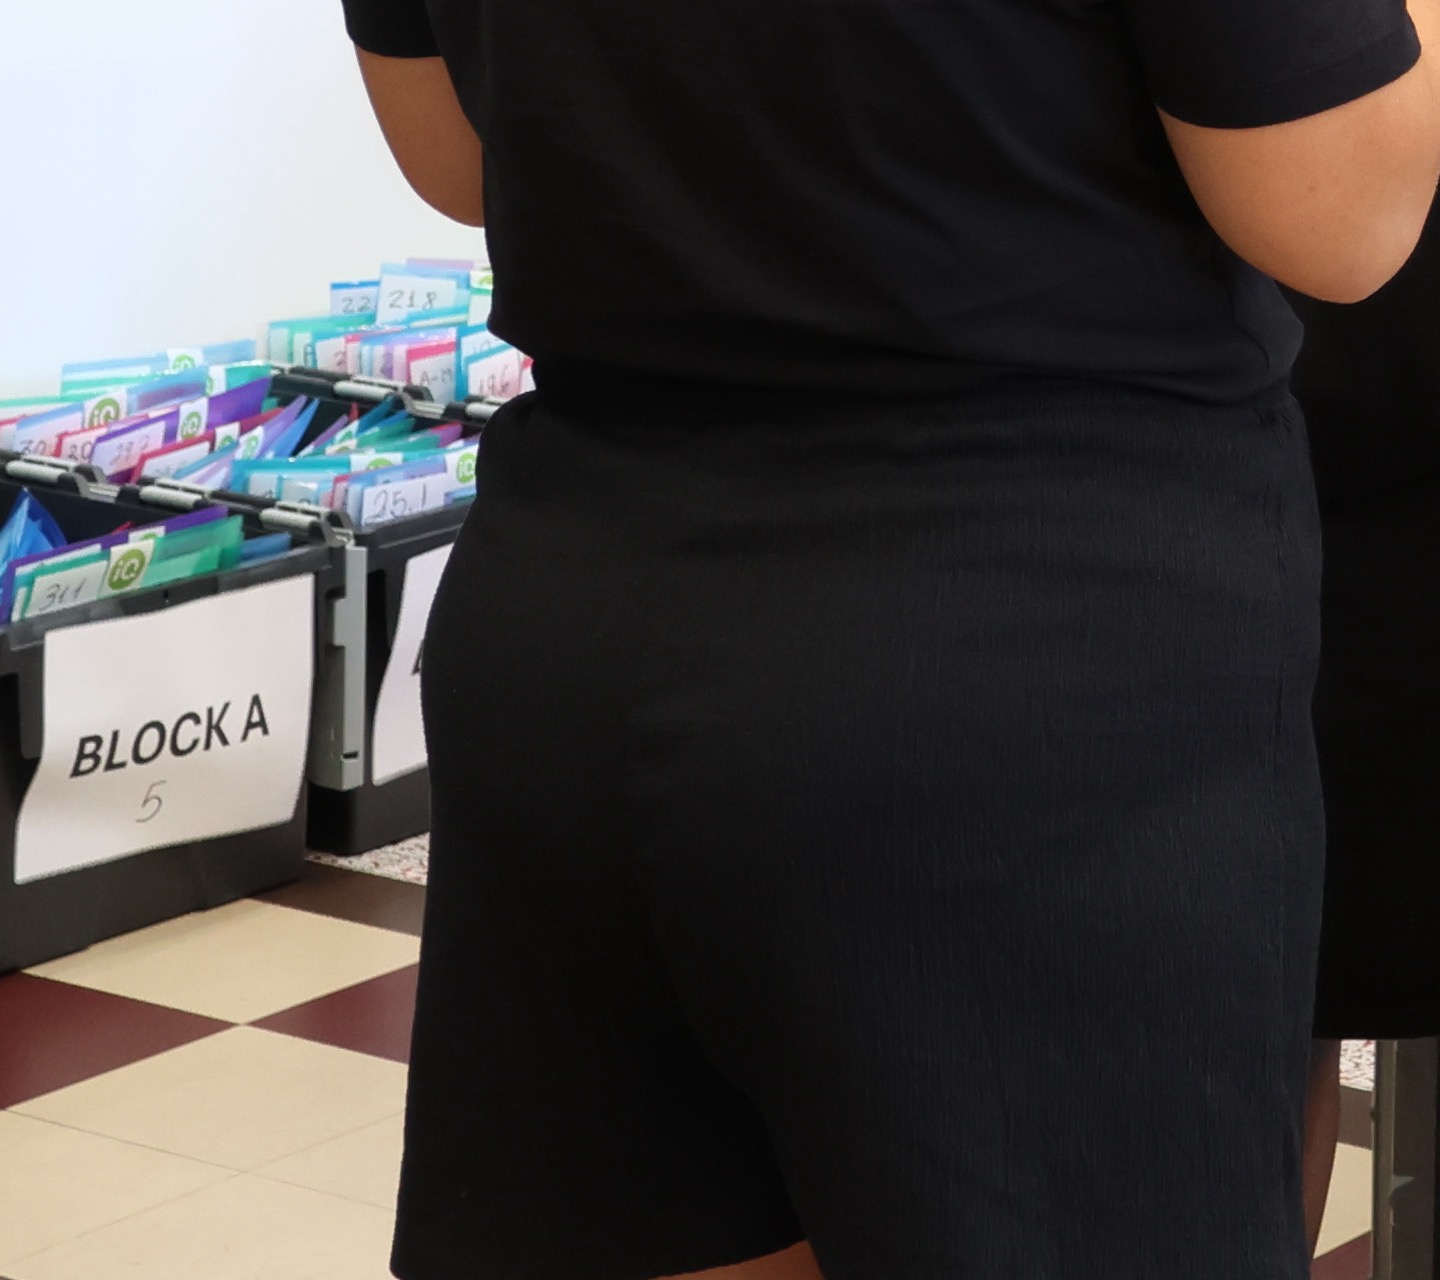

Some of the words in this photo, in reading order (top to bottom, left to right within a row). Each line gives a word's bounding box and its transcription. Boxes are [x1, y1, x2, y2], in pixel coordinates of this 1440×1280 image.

[113, 557, 141, 583] iQ
[69, 701, 231, 779] BLOCK
[241, 693, 270, 743] A
[136, 780, 167, 824] 5
